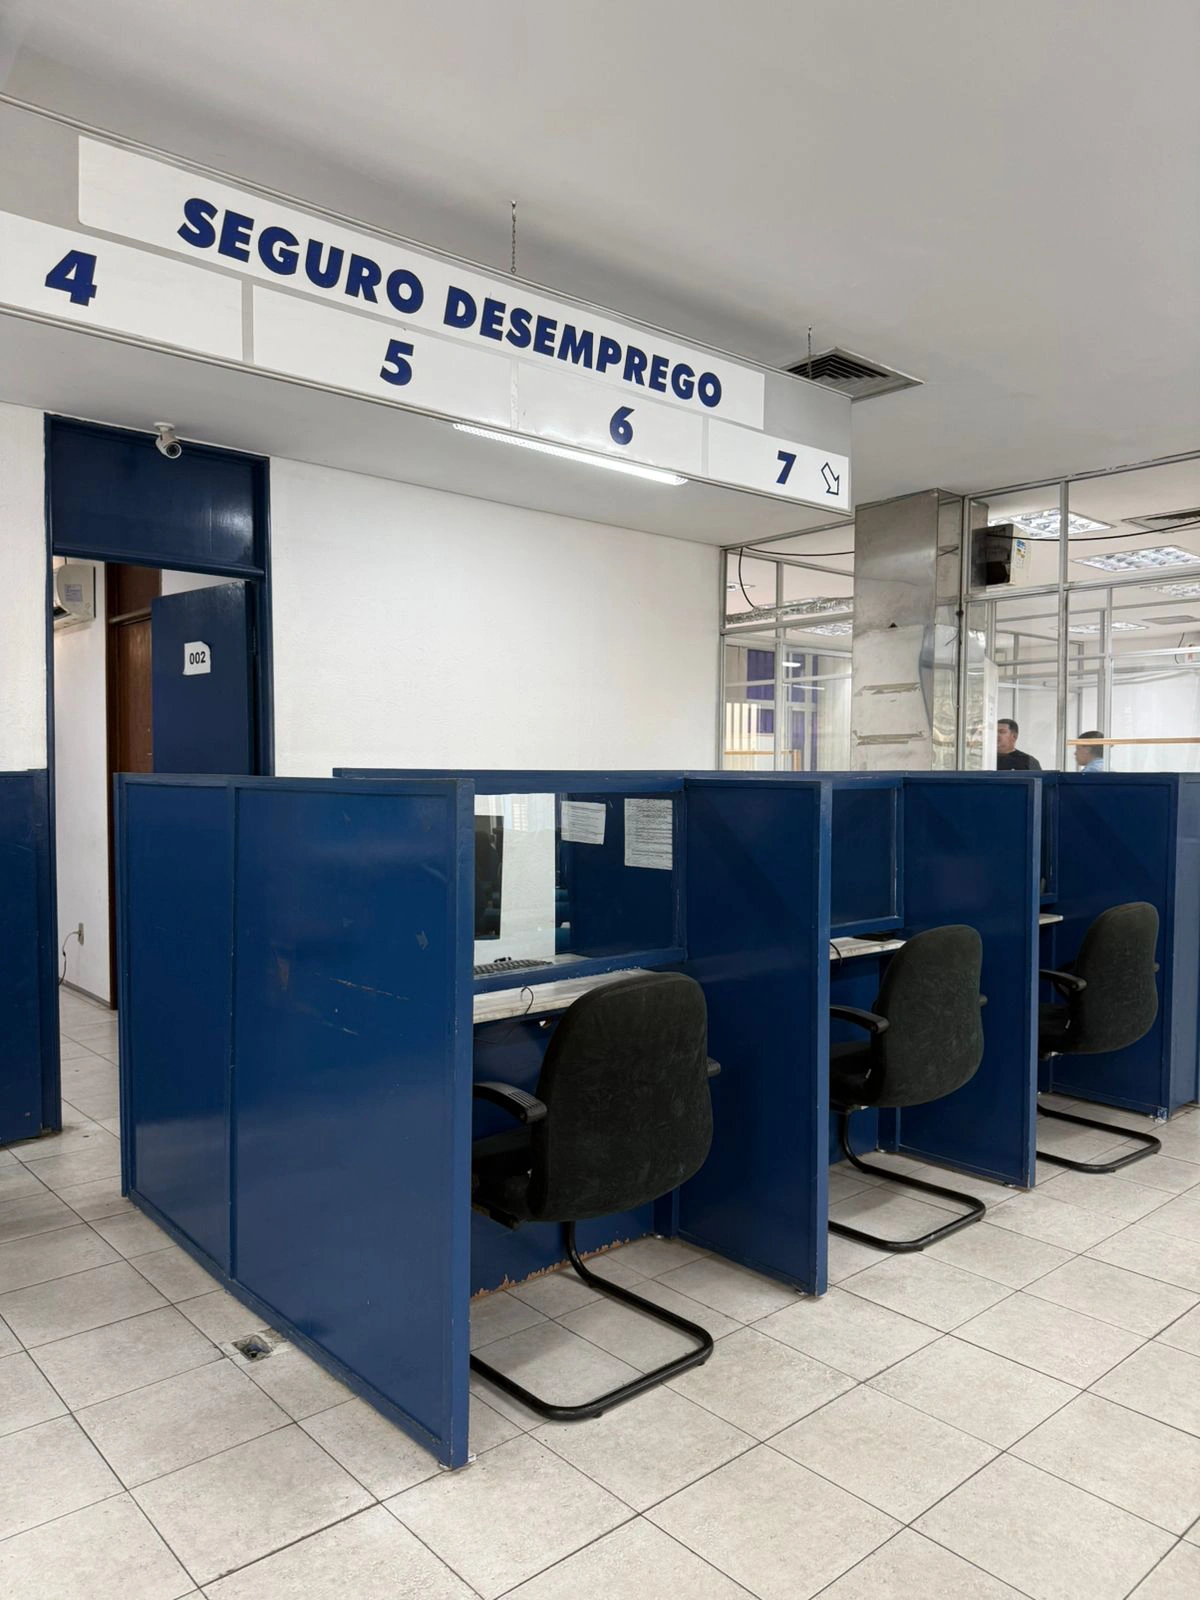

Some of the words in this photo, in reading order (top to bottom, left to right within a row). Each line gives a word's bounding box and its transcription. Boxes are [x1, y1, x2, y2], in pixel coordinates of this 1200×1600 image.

[44, 249, 98, 307] 4
[176, 197, 424, 314] SEGURO
[443, 285, 722, 408] DESEMPREGO
[379, 338, 414, 386] 5
[609, 406, 635, 445] 6
[776, 450, 797, 485] 7
[189, 651, 206, 665] 002
